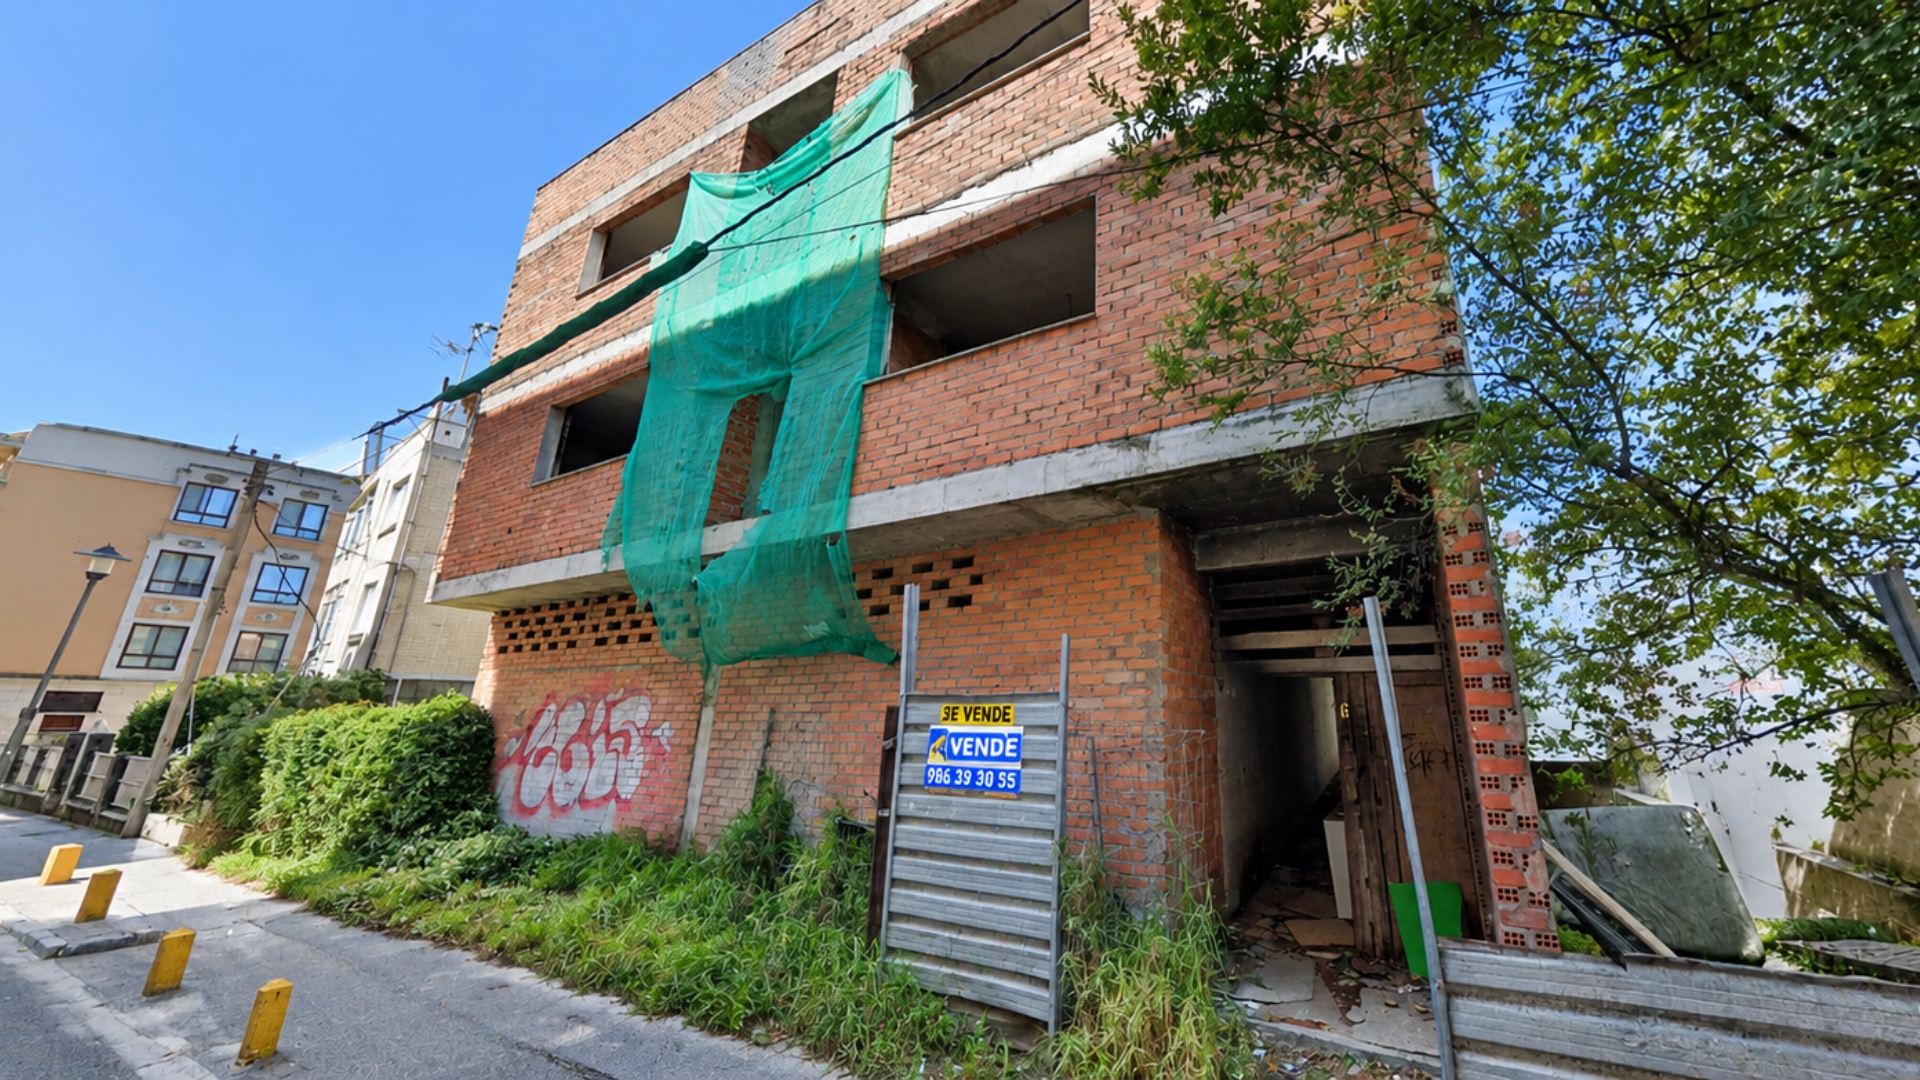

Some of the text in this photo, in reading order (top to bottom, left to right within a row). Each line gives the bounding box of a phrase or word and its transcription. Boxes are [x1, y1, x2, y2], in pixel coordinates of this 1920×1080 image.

[963, 705, 1012, 723] VENDE
[950, 737, 1019, 758] VENDE
[927, 767, 1017, 789] 986 39 30 55
